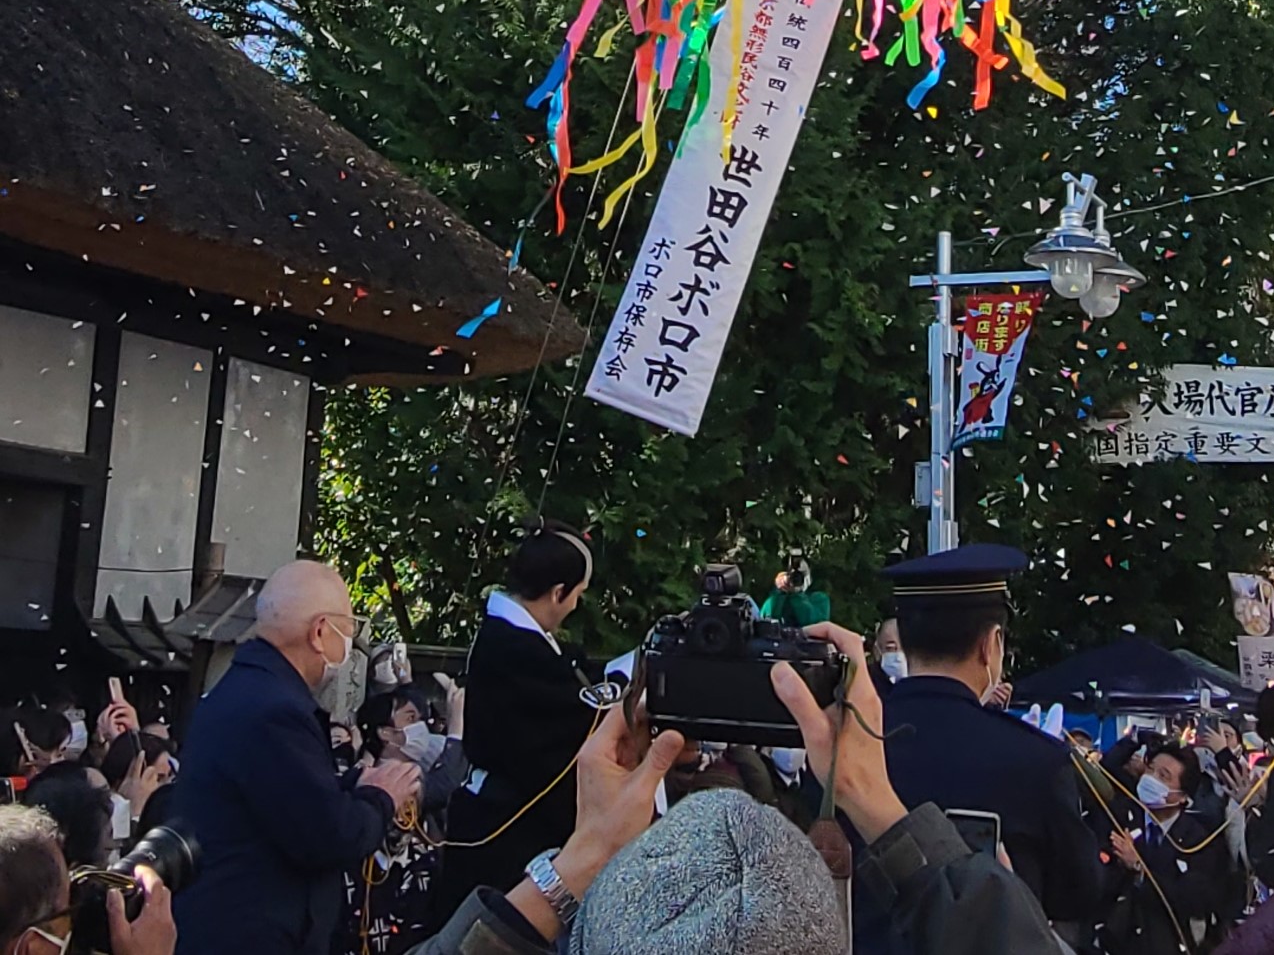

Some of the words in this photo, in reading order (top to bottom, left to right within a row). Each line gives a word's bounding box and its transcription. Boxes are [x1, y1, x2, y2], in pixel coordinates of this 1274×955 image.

[604, 236, 677, 382] ボロ市保存会
[643, 144, 764, 398] 世田谷ボロ市
